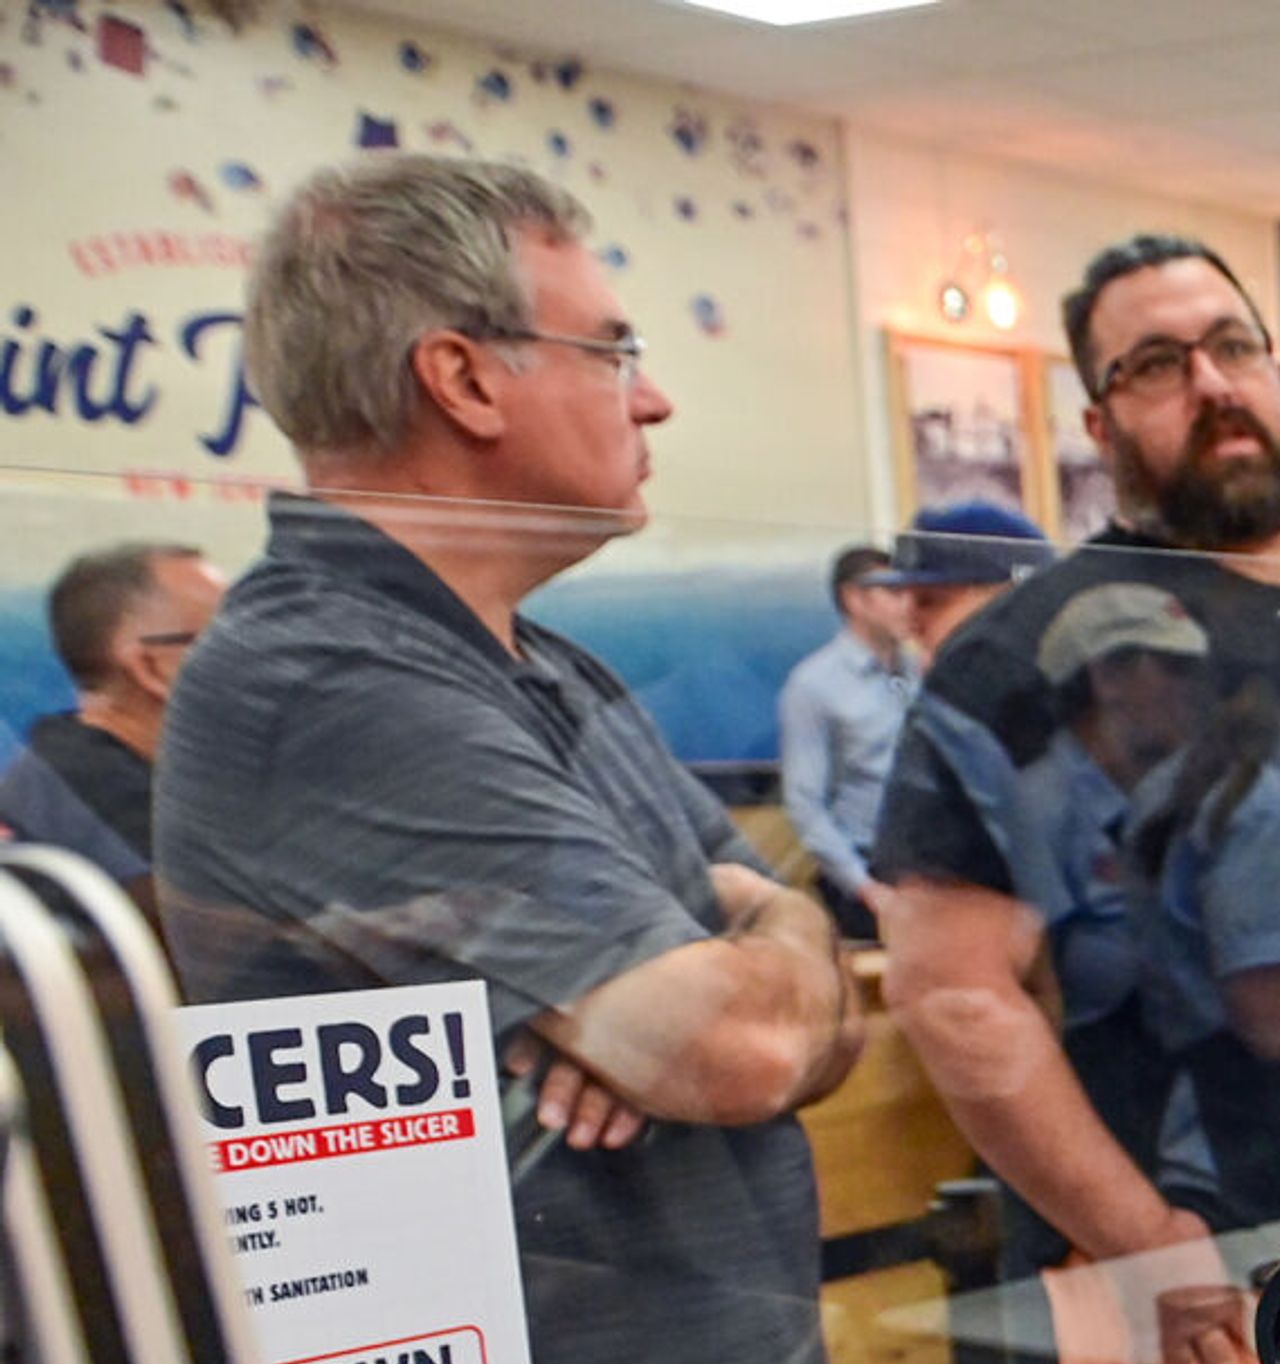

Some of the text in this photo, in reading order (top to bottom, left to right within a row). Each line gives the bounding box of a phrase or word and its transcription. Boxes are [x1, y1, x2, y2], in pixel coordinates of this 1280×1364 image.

[69, 229, 256, 279] ESTABLIS
[227, 1133, 317, 1168] DOWN
[322, 1122, 377, 1152] THE
[381, 1112, 461, 1146] SLICER
[267, 1200, 279, 1219] 5
[284, 1194, 325, 1217] HOT.
[269, 1268, 370, 1303] SANITATION
